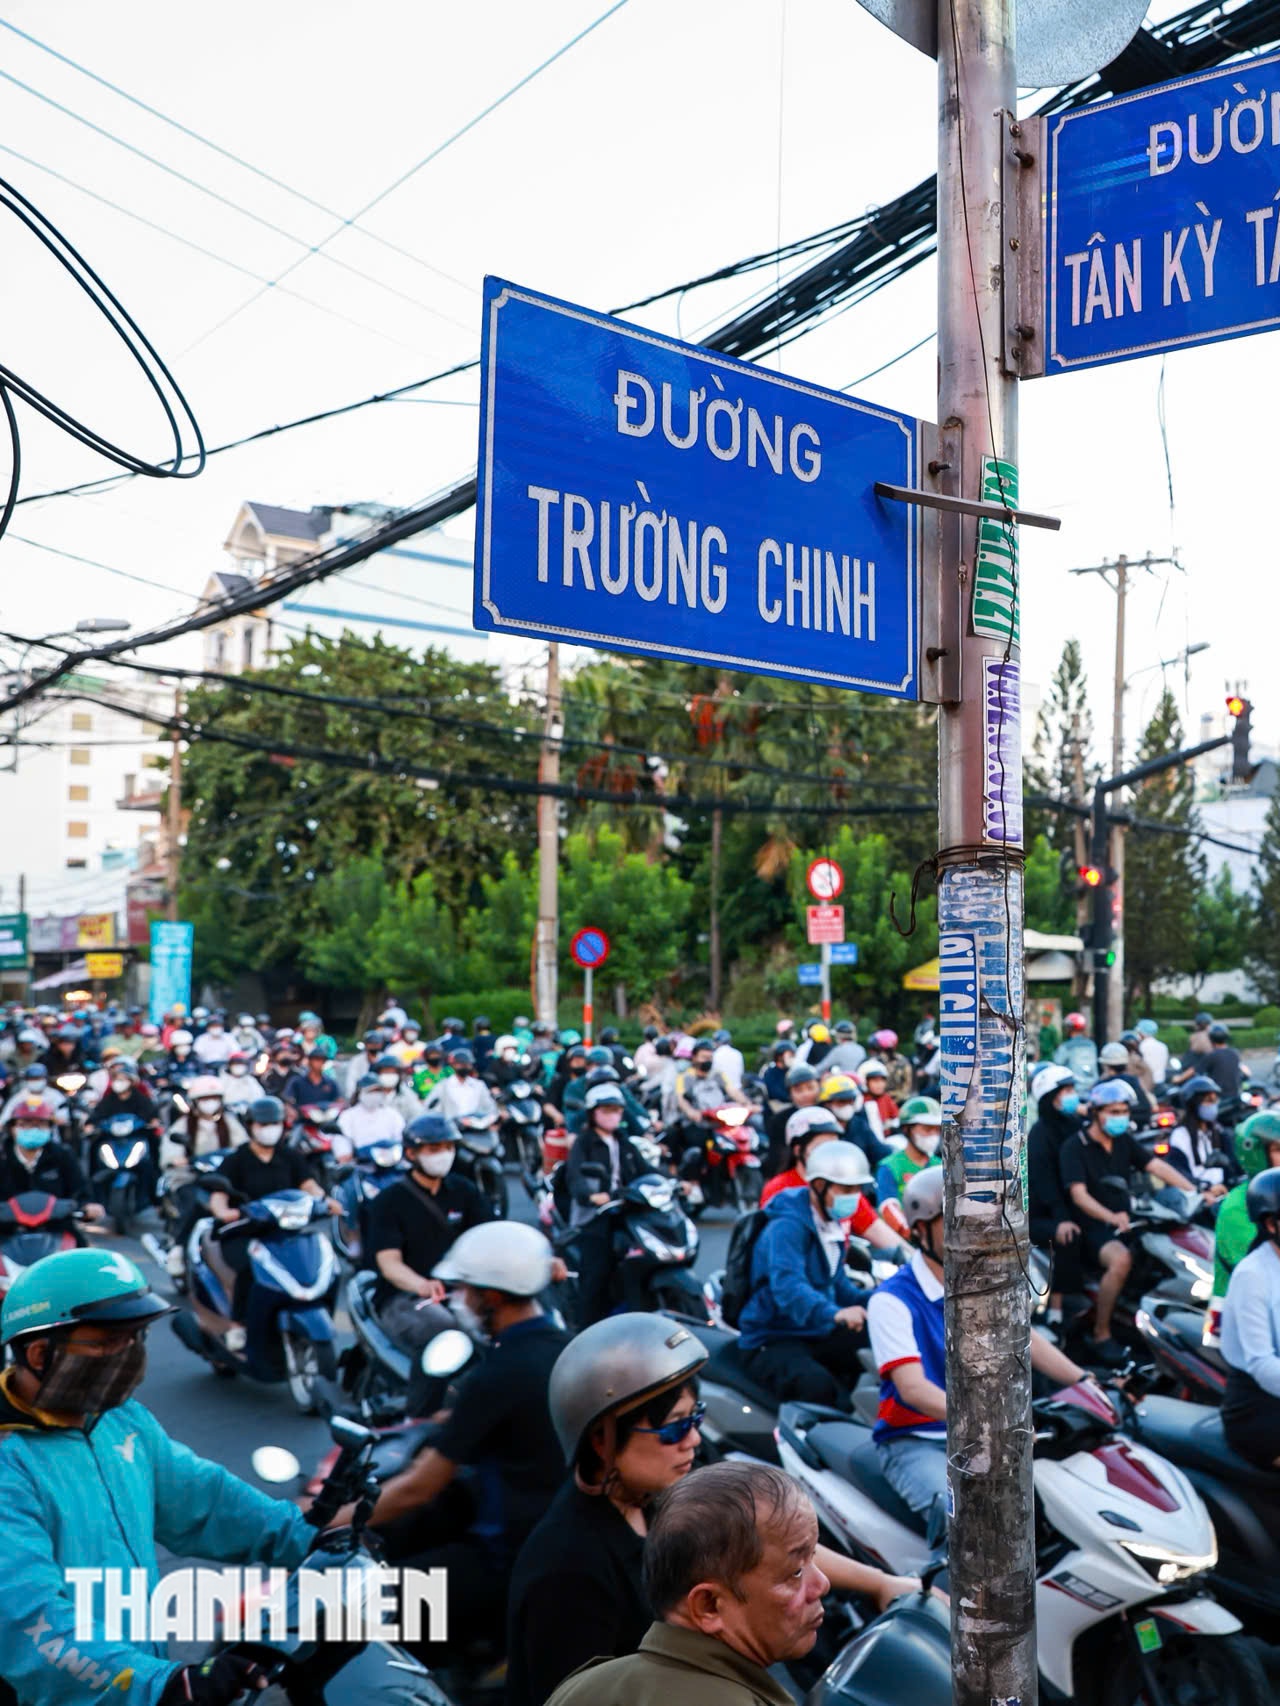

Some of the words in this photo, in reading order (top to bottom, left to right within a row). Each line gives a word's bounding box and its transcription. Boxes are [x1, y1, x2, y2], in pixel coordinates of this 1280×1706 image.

[1064, 231, 1142, 327] TÂN
[1163, 201, 1223, 307] KỲ
[614, 369, 822, 483] ĐƯỜNG
[528, 480, 729, 614] TRƯỜNG
[757, 537, 876, 642] CHINH
